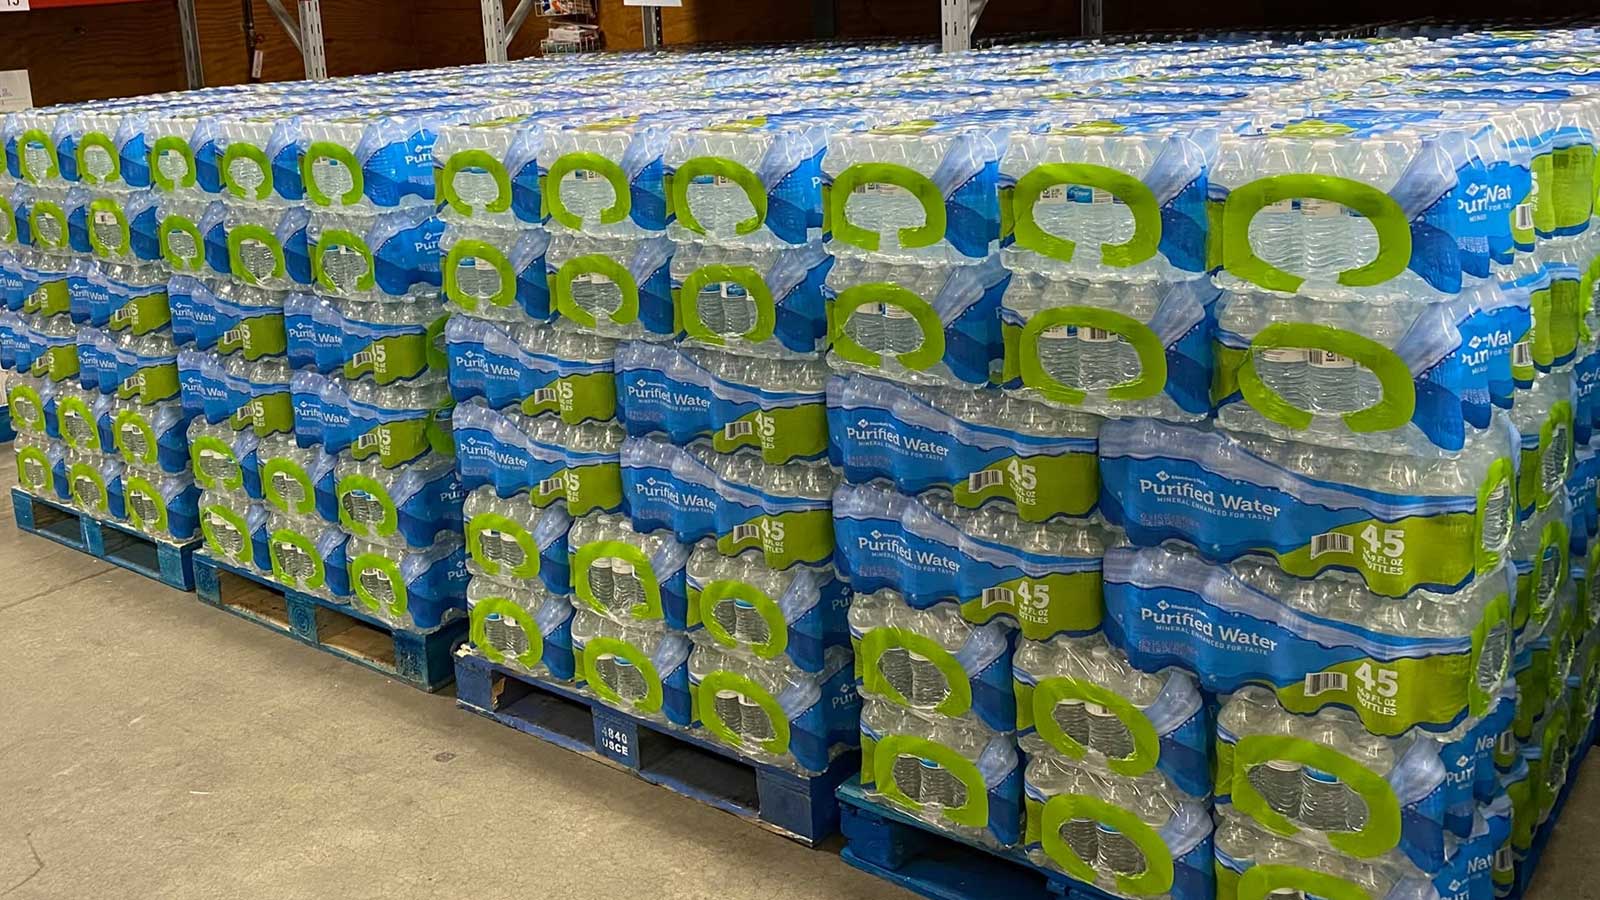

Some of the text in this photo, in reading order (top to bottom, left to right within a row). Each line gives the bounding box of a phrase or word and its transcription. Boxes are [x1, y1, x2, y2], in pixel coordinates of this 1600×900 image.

[627, 385, 672, 403] Purified
[673, 393, 711, 408] Water
[755, 412, 775, 437] 45
[846, 426, 949, 457] Purified Water
[1007, 459, 1037, 490] 45
[635, 483, 717, 512] Purified Water
[1139, 479, 1215, 506] Purified
[1220, 494, 1281, 518] Water
[1156, 497, 1190, 506] MINERAL
[1229, 511, 1245, 519] FOR
[1247, 512, 1271, 521] TASTE
[761, 518, 785, 541] 45
[1360, 524, 1405, 558] 45
[858, 537, 912, 561] Purified
[915, 550, 960, 572] Water
[1377, 555, 1388, 565] FL
[1390, 558, 1403, 566] OZ
[1017, 581, 1050, 609] 45
[1141, 607, 1213, 637] Purified
[1218, 625, 1278, 651] Water
[1155, 625, 1190, 634] MINERAL
[1226, 644, 1243, 652] FOR
[1245, 646, 1268, 655] TASTE
[1354, 662, 1398, 698] 45
[1371, 695, 1382, 705] FL
[1384, 698, 1397, 707] OZ
